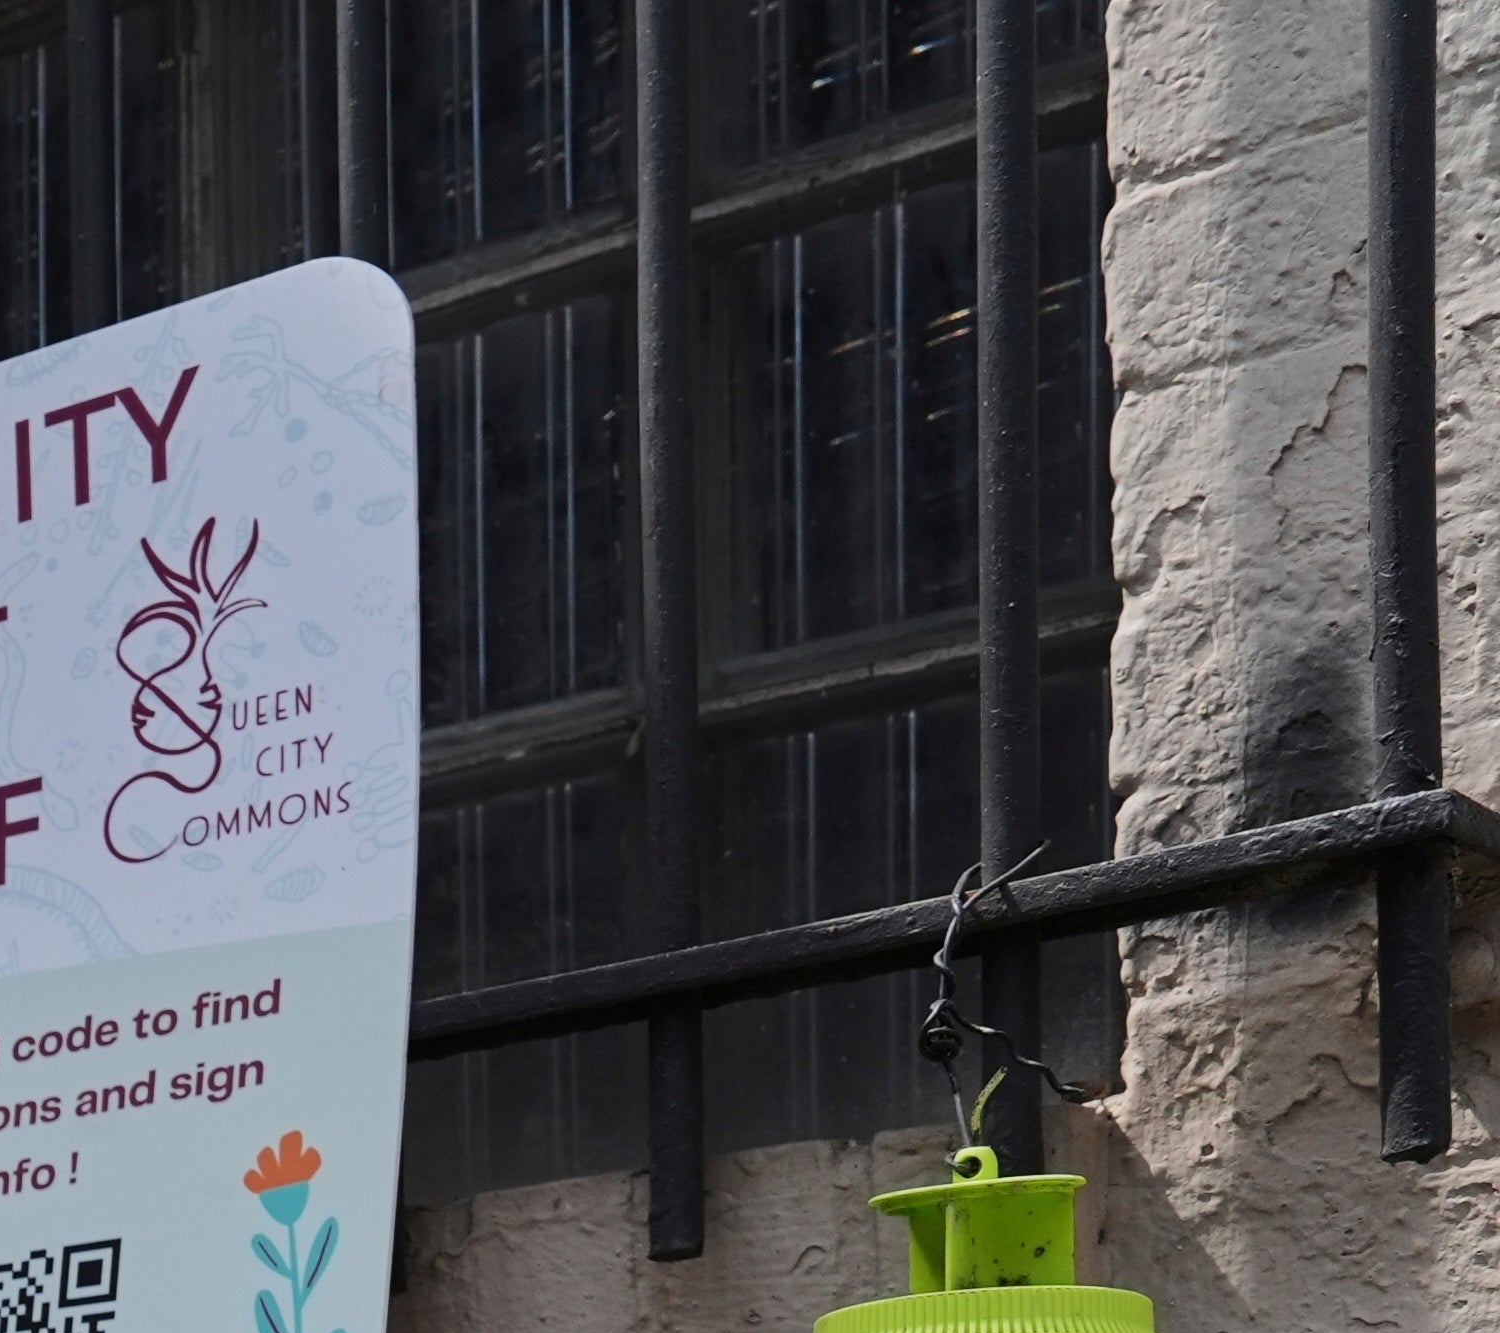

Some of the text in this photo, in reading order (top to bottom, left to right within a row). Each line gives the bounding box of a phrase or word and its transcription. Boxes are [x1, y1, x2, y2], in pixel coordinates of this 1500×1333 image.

[256, 732, 333, 777] CITY
[12, 1015, 119, 1063] code
[133, 1006, 178, 1039] to
[192, 978, 283, 1030] find
[75, 1071, 156, 1117] and
[169, 1058, 265, 1103] sign
